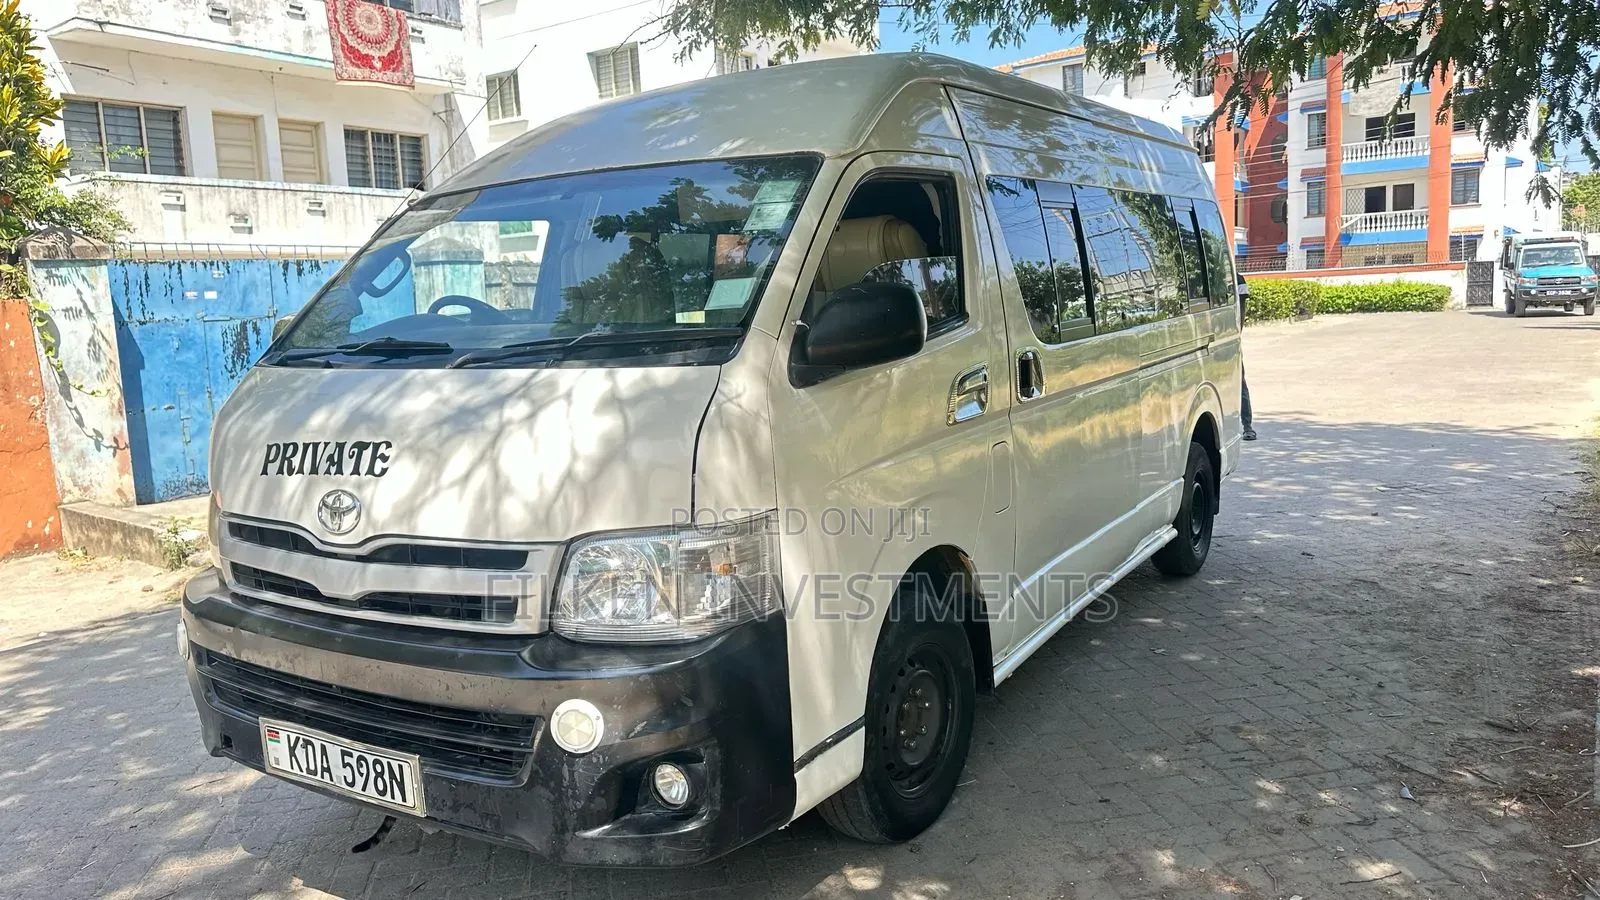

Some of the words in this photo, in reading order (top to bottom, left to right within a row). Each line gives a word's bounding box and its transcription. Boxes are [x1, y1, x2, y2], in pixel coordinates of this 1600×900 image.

[260, 440, 393, 478] PRIVATE
[286, 733, 335, 783] KDA
[340, 748, 407, 803] 598N
